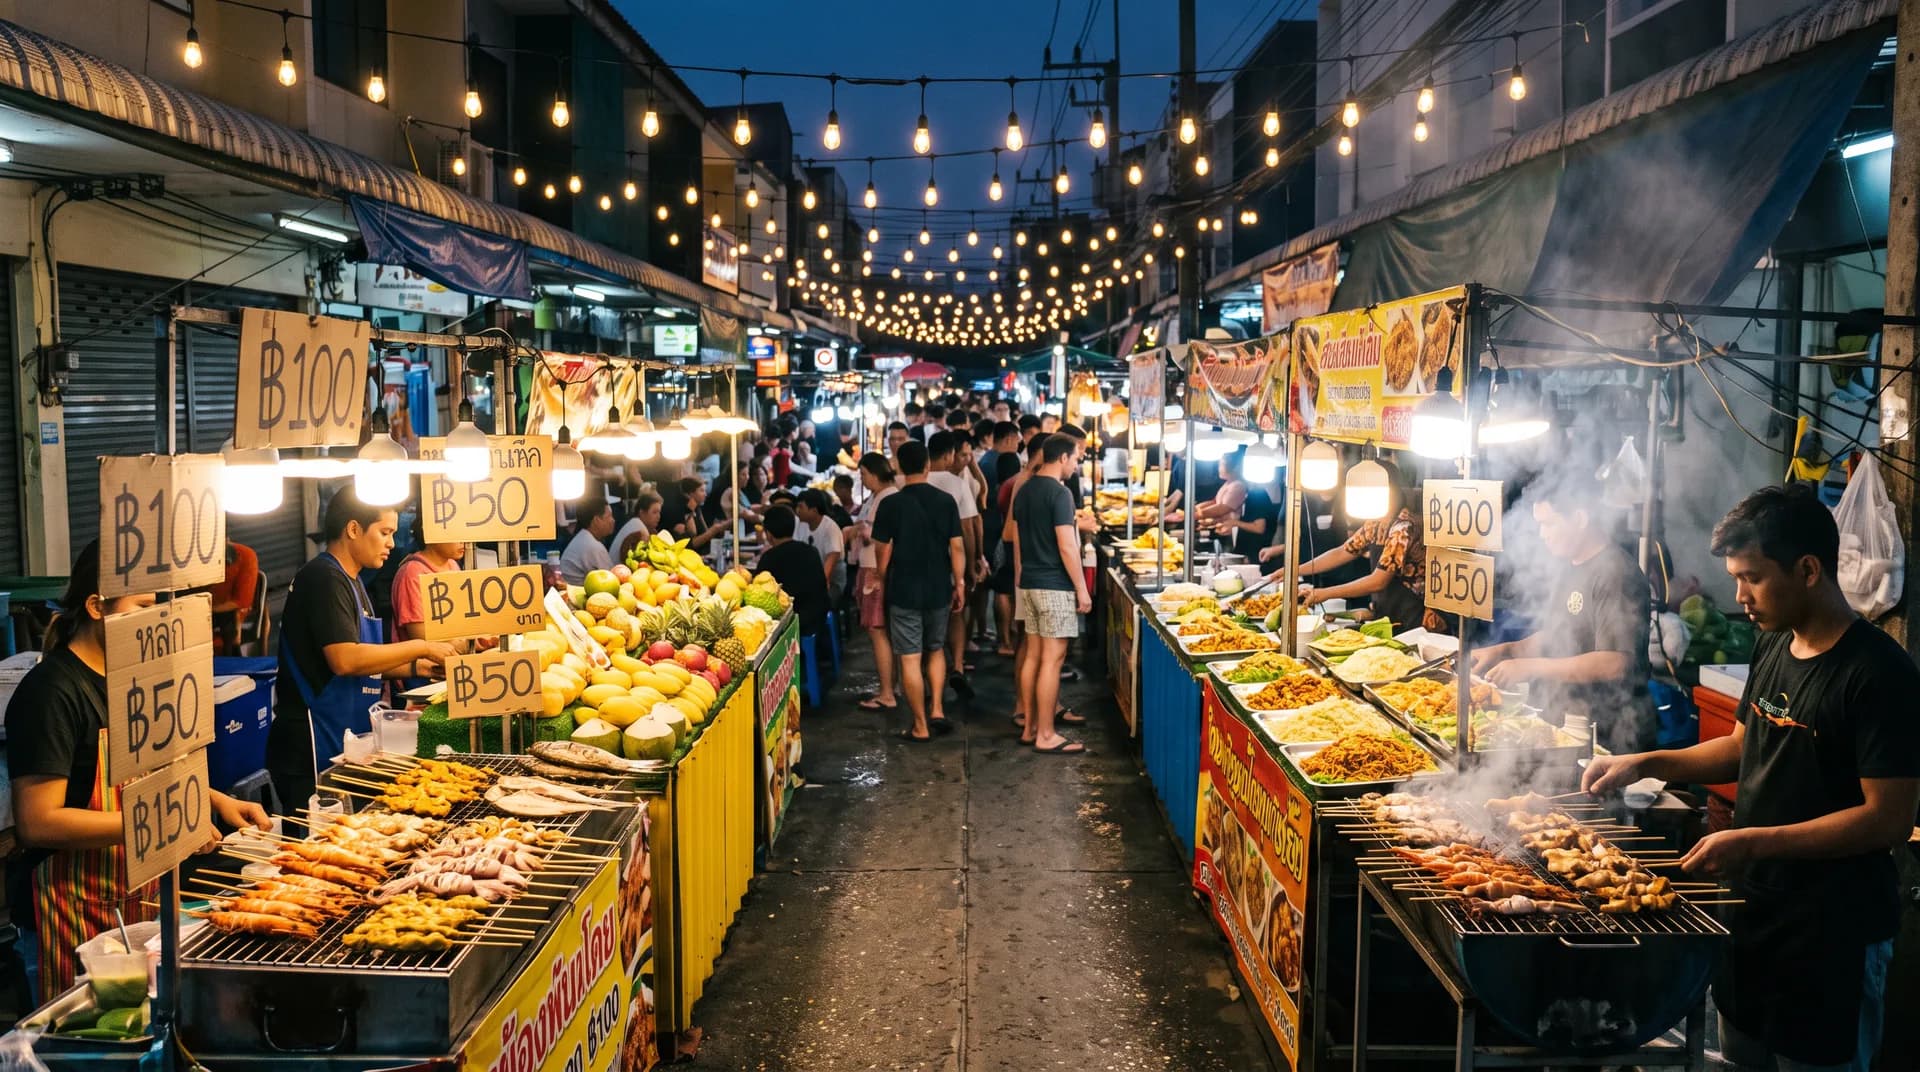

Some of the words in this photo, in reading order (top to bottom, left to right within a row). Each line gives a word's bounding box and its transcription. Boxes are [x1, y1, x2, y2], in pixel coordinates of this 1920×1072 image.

[1430, 493, 1493, 539] ฿100
[428, 572, 535, 624] ฿100
[1430, 556, 1487, 606] ฿150
[133, 775, 200, 862] ฿150
